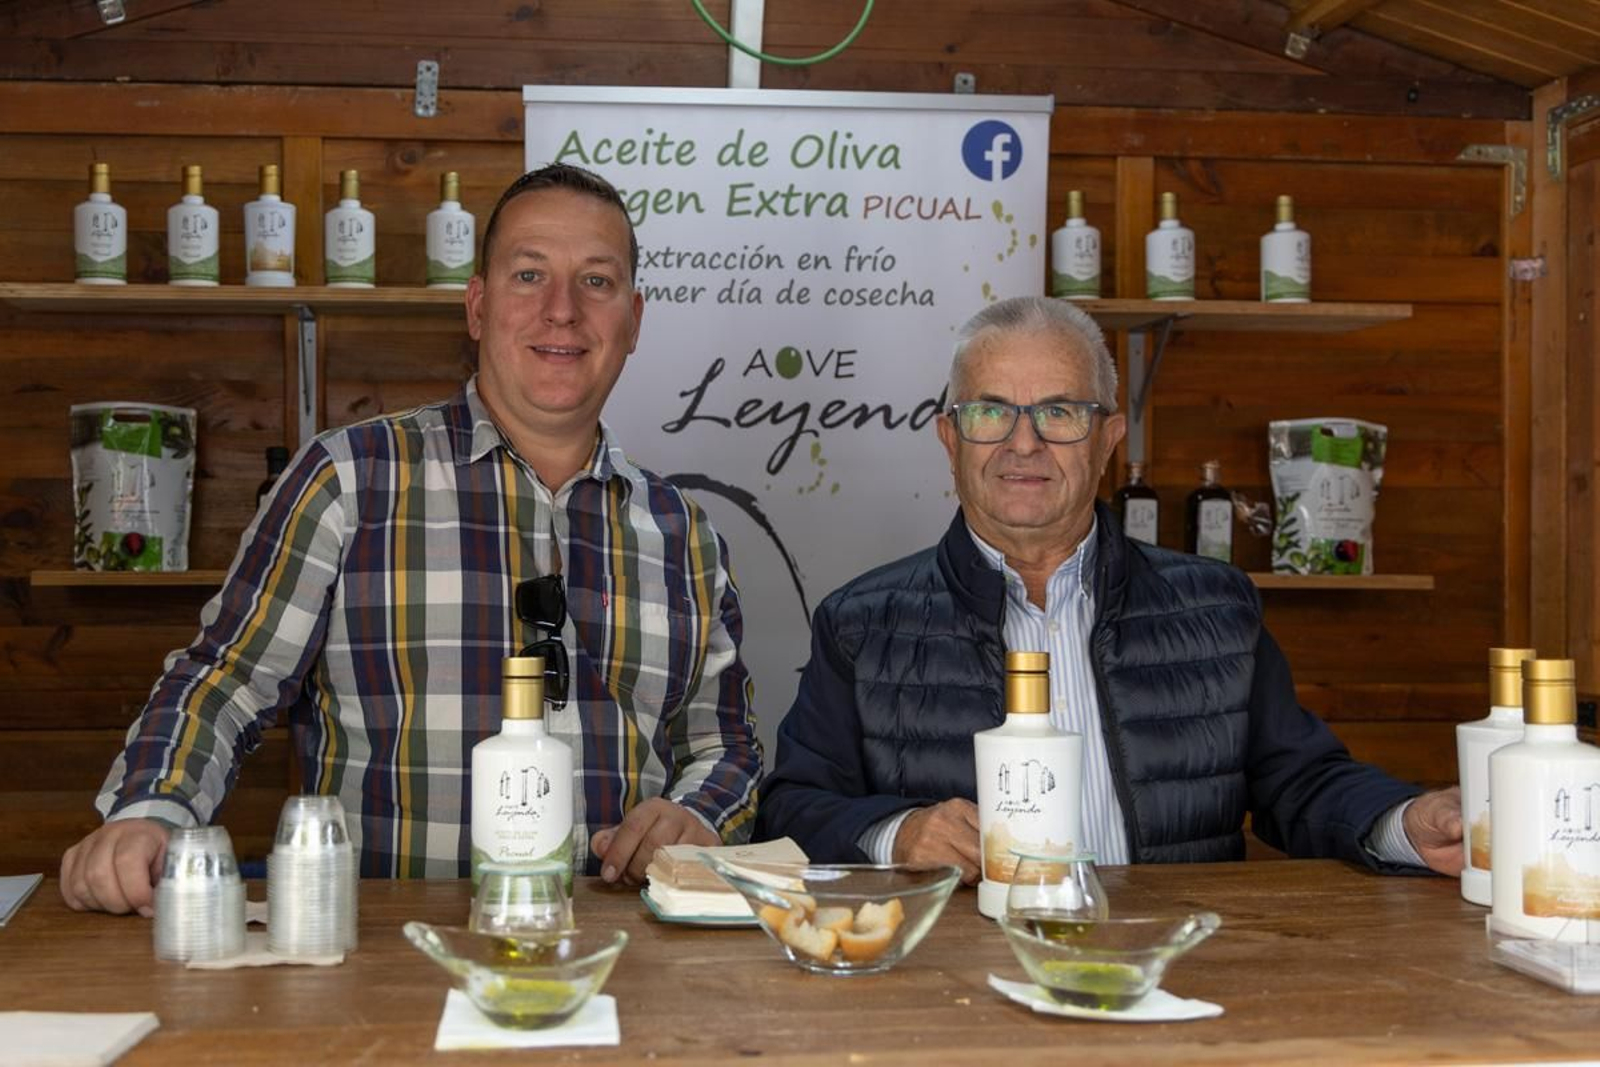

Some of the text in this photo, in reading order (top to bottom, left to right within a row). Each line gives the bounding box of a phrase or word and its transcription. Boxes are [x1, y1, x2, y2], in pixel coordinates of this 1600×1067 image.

[554, 127, 902, 170] Aceite de Oliva
[618, 182, 982, 228] gen Extra PICUAL
[797, 254, 832, 271] en
[845, 244, 897, 273] frío
[717, 278, 763, 305] día
[776, 278, 811, 305] de
[823, 281, 935, 307] cosecha
[661, 357, 953, 476] Leyend
